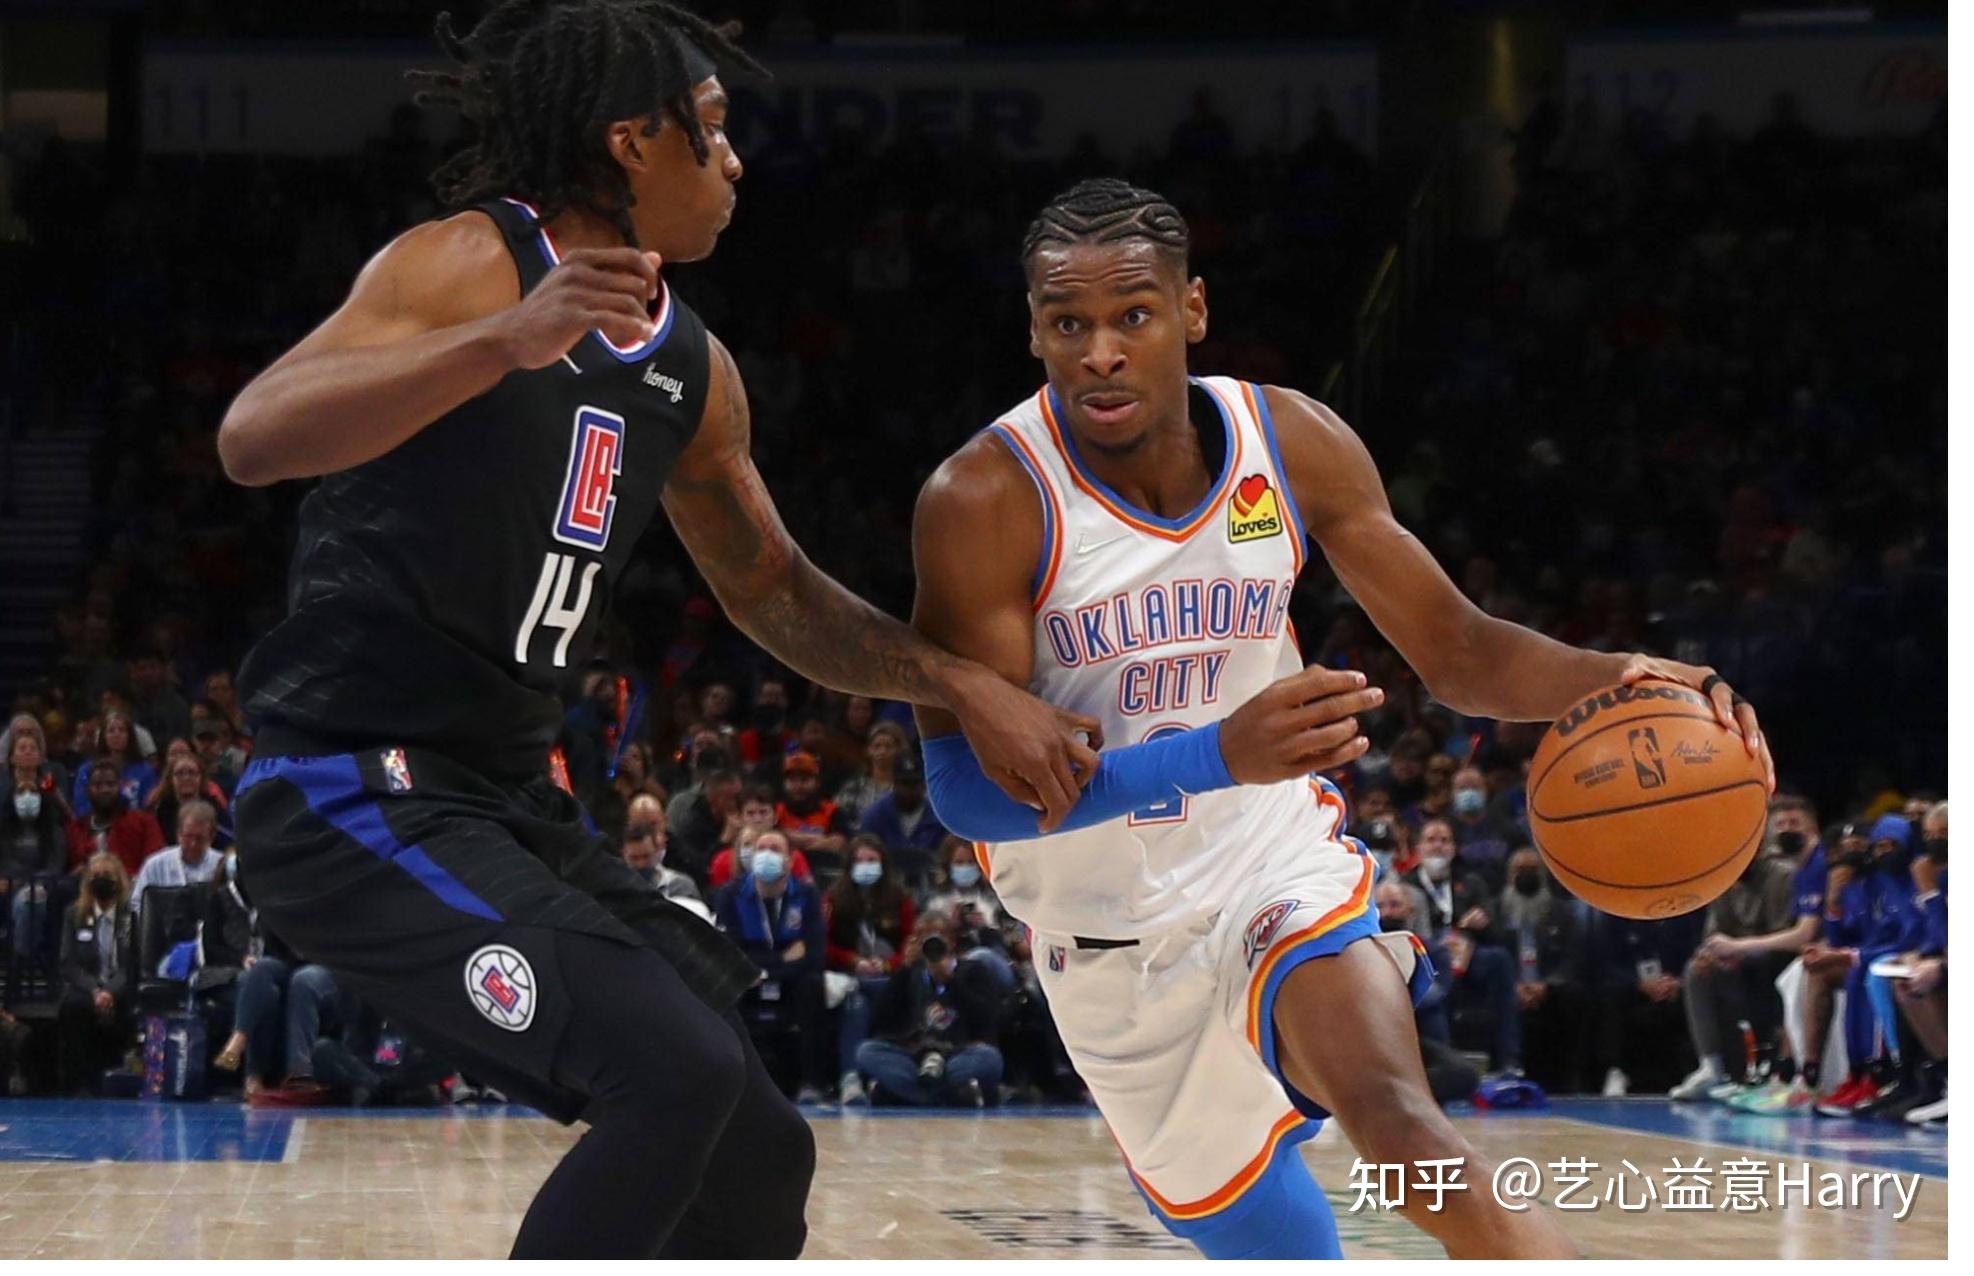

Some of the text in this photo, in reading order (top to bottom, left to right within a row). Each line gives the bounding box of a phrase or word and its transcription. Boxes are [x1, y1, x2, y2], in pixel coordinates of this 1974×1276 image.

[643, 362, 684, 403] honey
[514, 552, 601, 667] 14
[1044, 579, 1292, 668] OKLAHOMA
[1119, 649, 1231, 716] CITY
